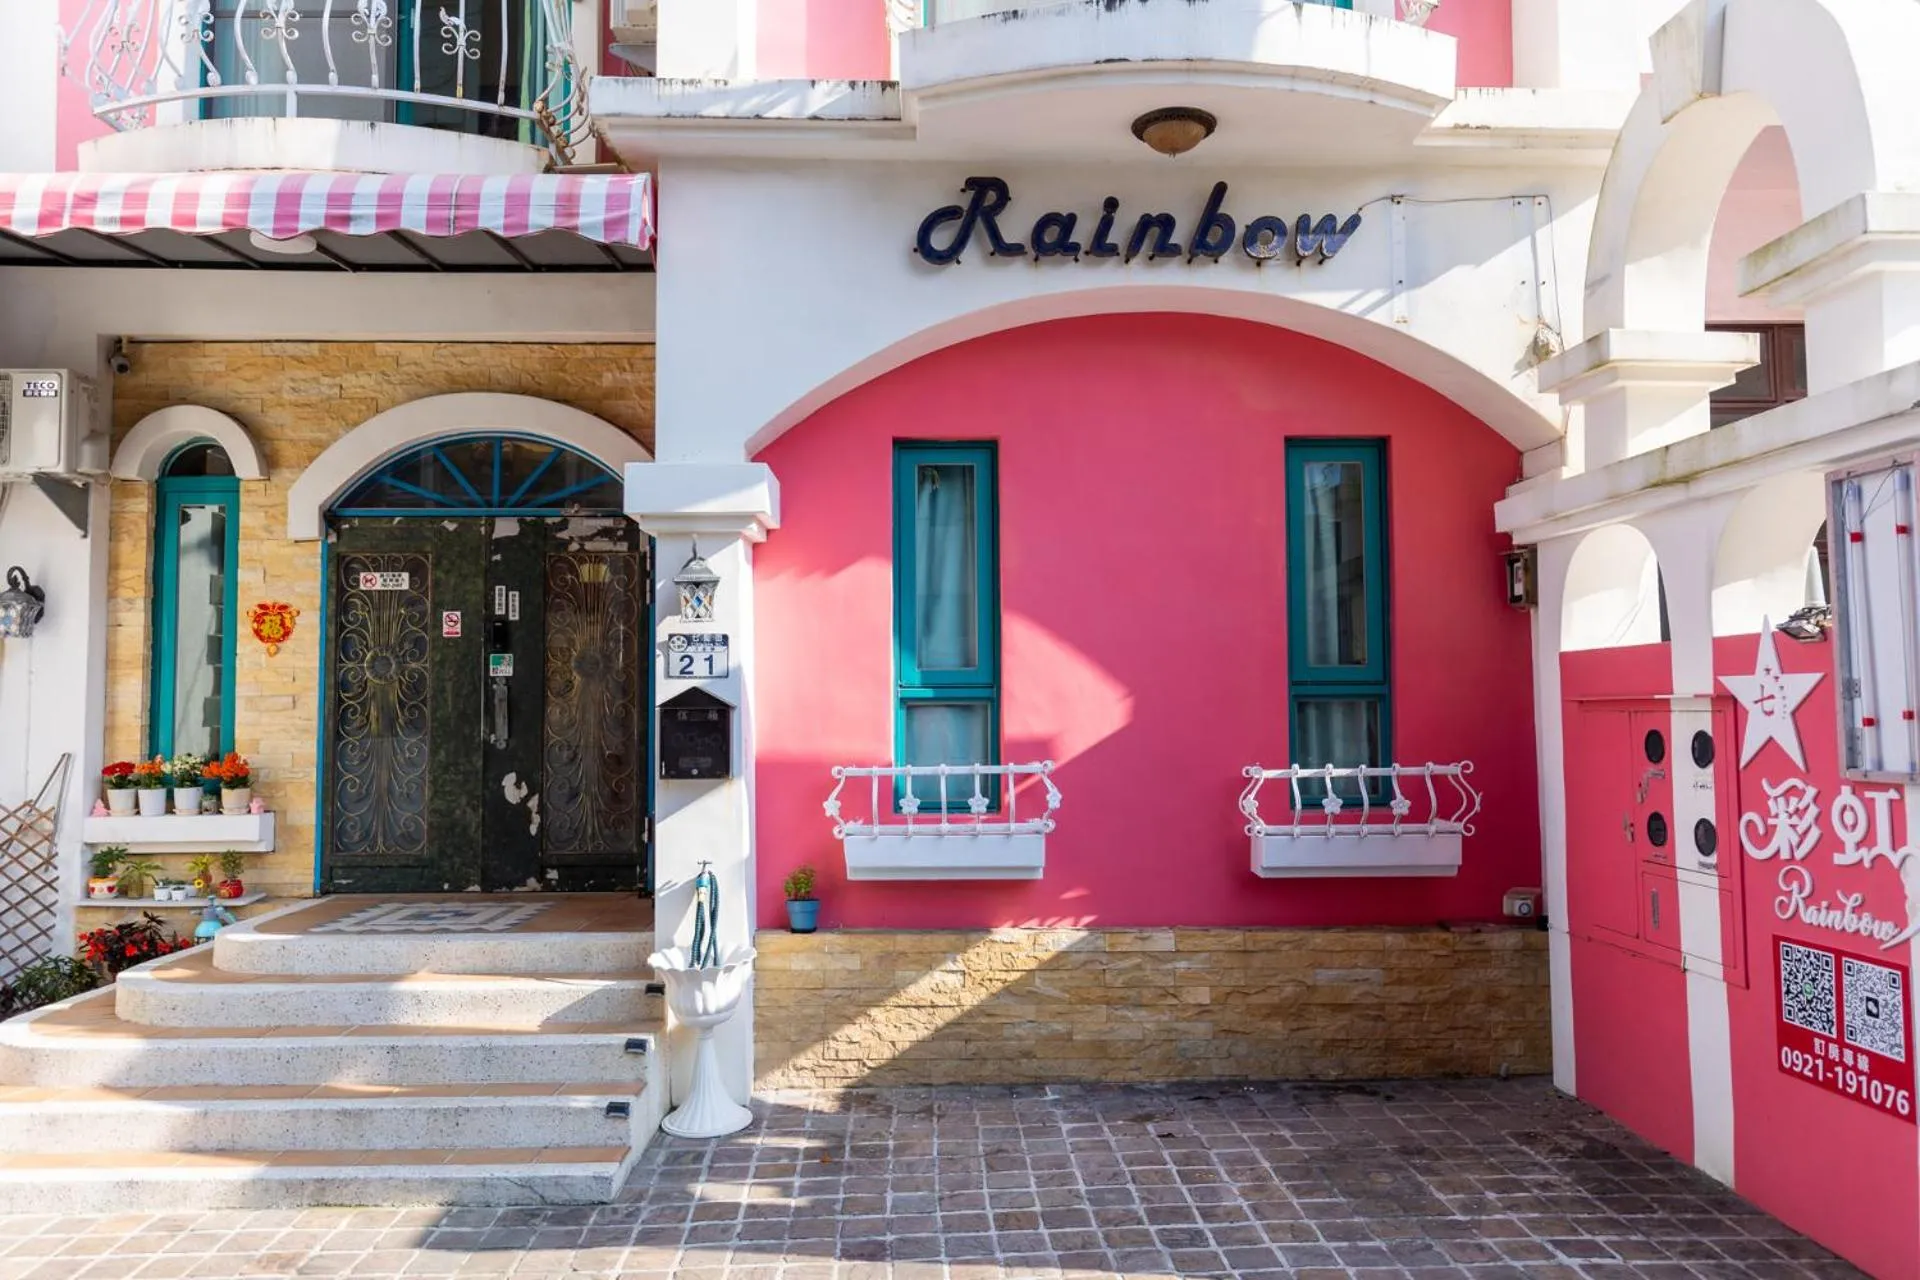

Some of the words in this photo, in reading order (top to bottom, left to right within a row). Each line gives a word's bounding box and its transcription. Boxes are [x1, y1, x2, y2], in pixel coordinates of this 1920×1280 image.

[915, 176, 1362, 265] Rainbow
[679, 654, 714, 675] 21
[1739, 777, 1908, 868] 彩虹
[1774, 864, 1900, 942] Rainbow
[1781, 1046, 1911, 1115] 0921-191076
